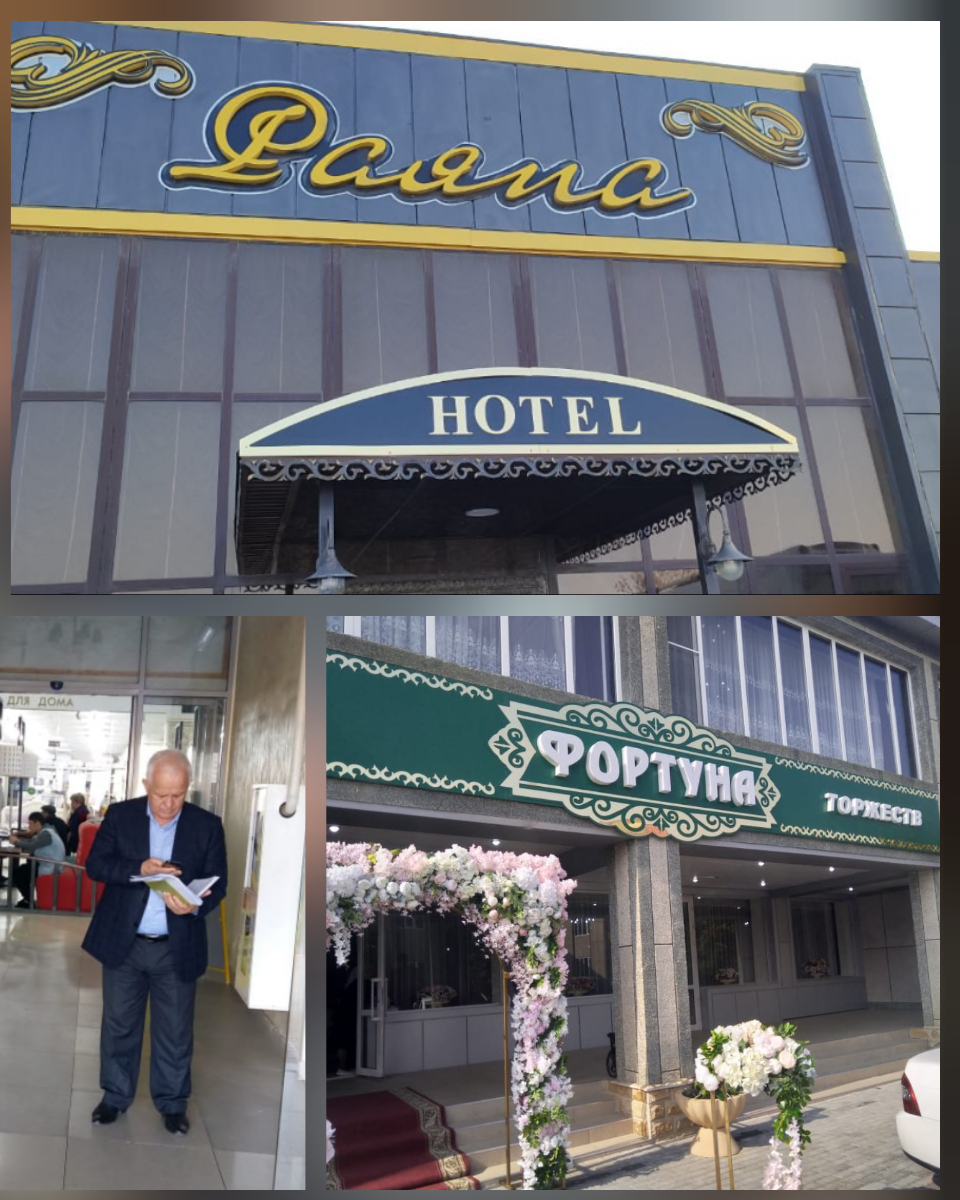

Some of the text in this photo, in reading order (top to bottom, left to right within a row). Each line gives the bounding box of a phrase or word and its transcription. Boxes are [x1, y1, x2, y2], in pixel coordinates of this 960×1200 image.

[428, 393, 642, 436] HOTEL
[6, 695, 30, 707] ДЛЯ
[37, 696, 74, 708] ДОМА
[536, 729, 758, 808] ФОРТУНА
[824, 791, 924, 827] ТОРЖЕСТВ
